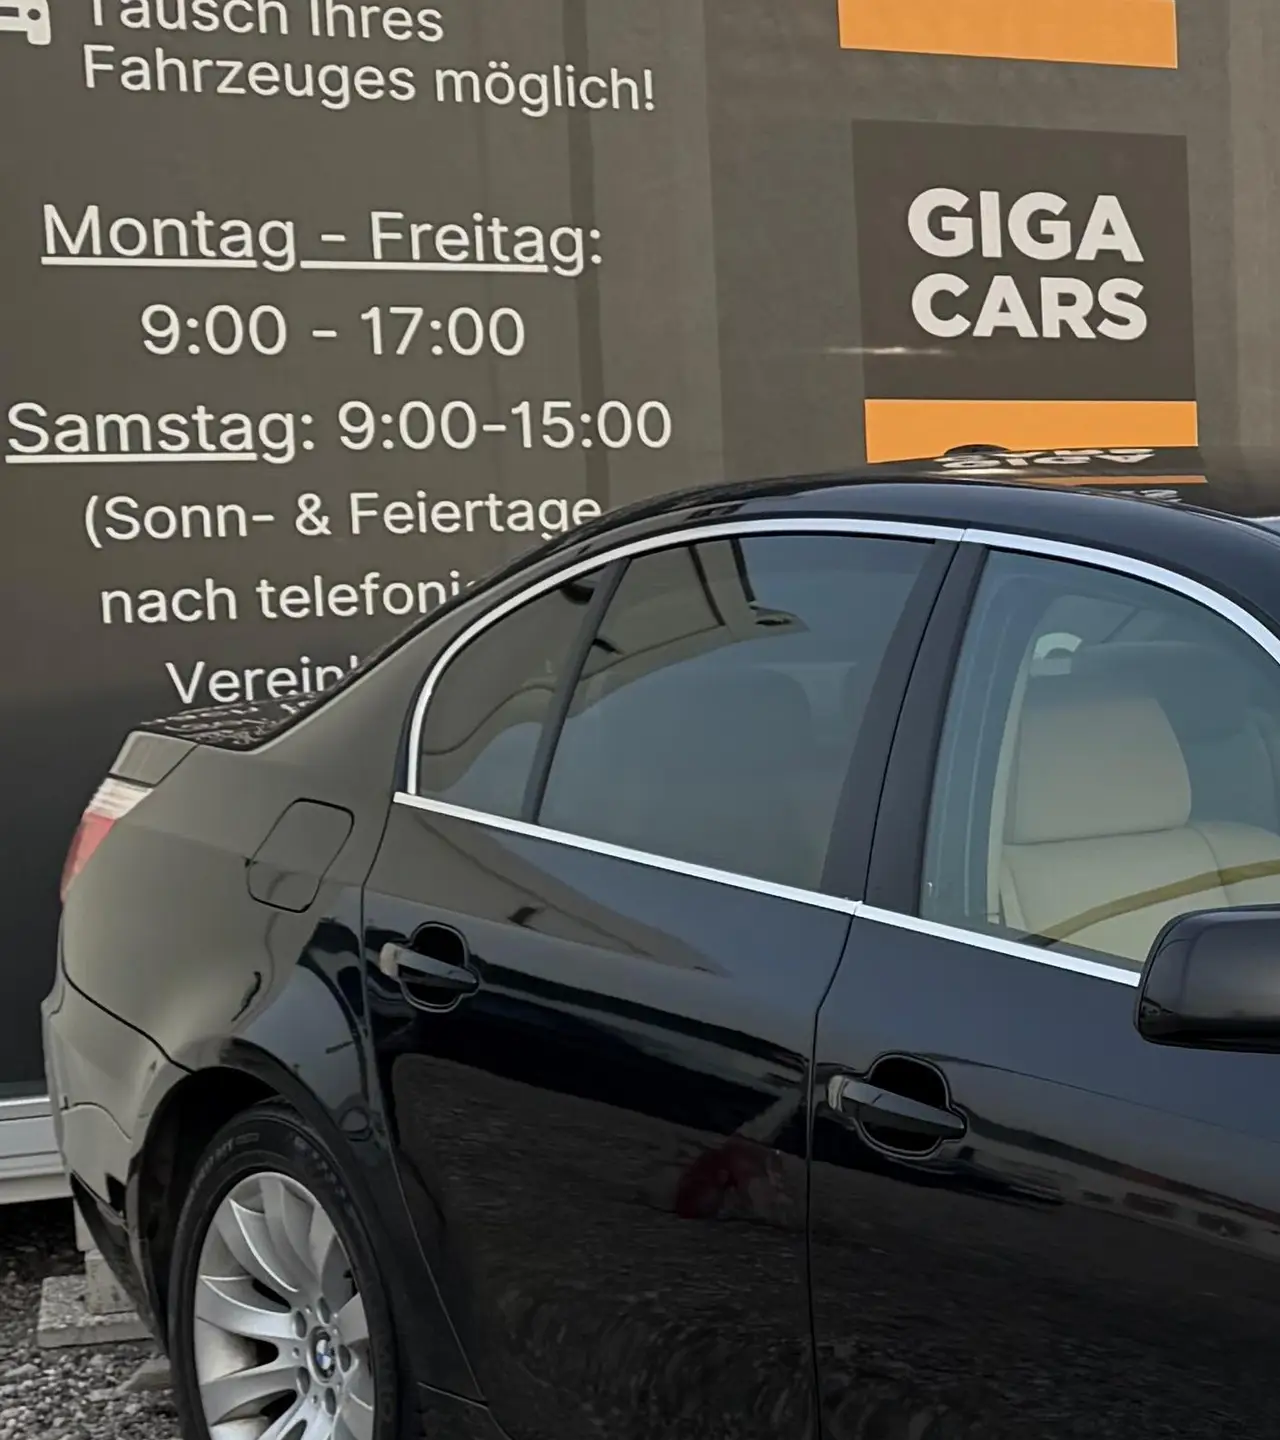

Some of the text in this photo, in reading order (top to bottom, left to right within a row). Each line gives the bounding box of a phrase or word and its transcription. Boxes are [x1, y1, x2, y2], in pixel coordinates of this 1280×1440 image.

[310, 0, 444, 42] Ihres
[83, 44, 655, 118] Fahrzeuges möglich!
[40, 203, 296, 272] Montag
[370, 211, 602, 277] Freitag:
[907, 187, 1145, 263] GIGA
[141, 303, 287, 355] 9:00
[360, 306, 525, 356] 17:00
[911, 272, 1147, 341] CARS
[5, 400, 672, 464] Samstag: 9:00-15:00
[85, 490, 602, 549] (Sonn- & Feiertage
[101, 570, 476, 624] nach telefoni
[165, 654, 358, 705] Verein
